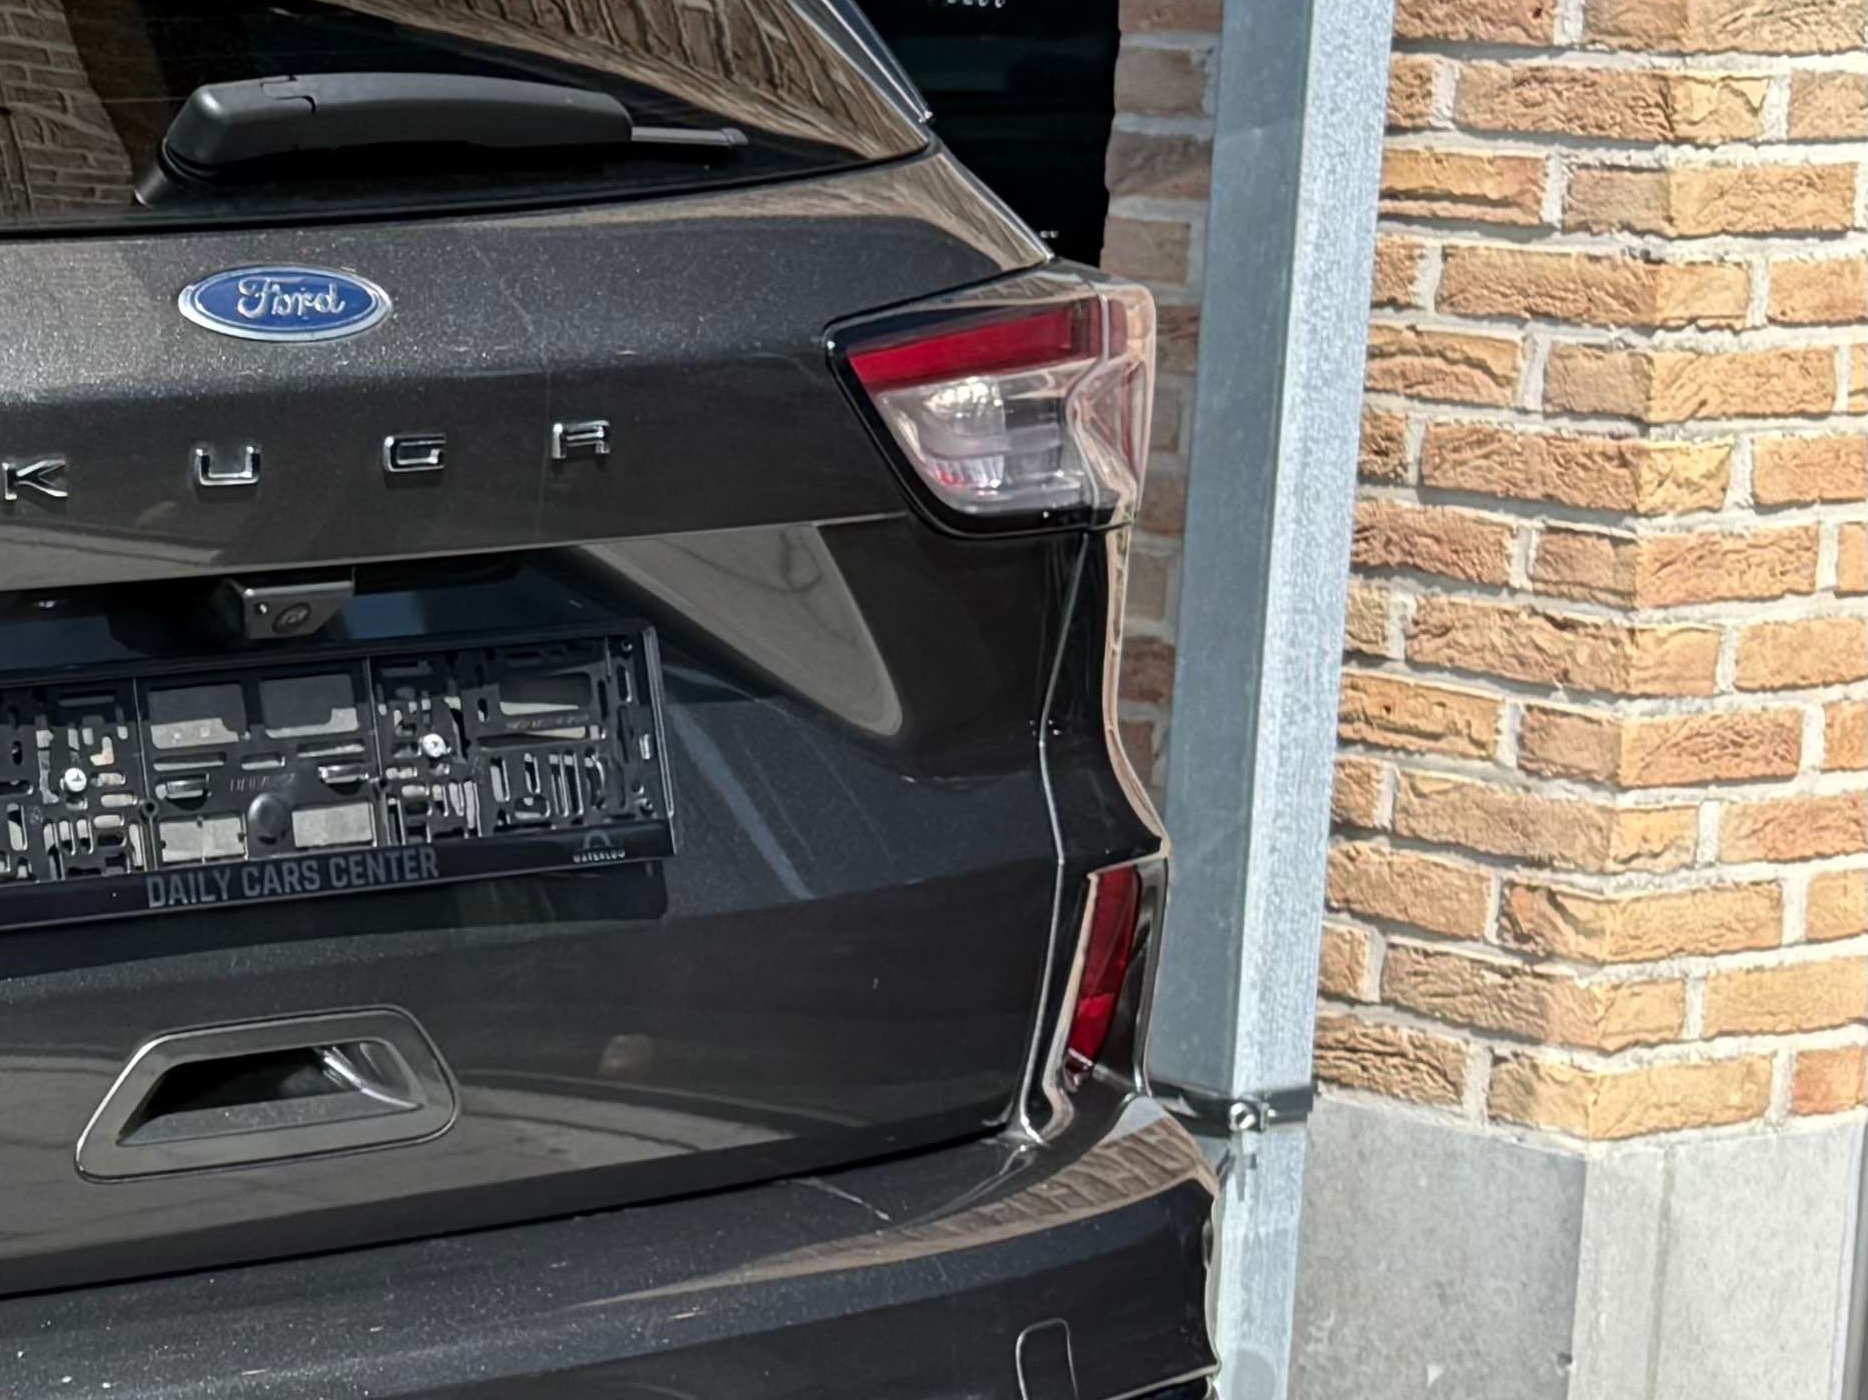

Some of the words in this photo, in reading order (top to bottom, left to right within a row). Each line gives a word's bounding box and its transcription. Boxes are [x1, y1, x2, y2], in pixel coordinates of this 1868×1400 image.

[236, 276, 346, 320] Ford
[3, 419, 611, 501] KUGA
[145, 867, 233, 909] DAILY
[241, 859, 317, 898] CARS
[329, 847, 440, 888] CENTER
